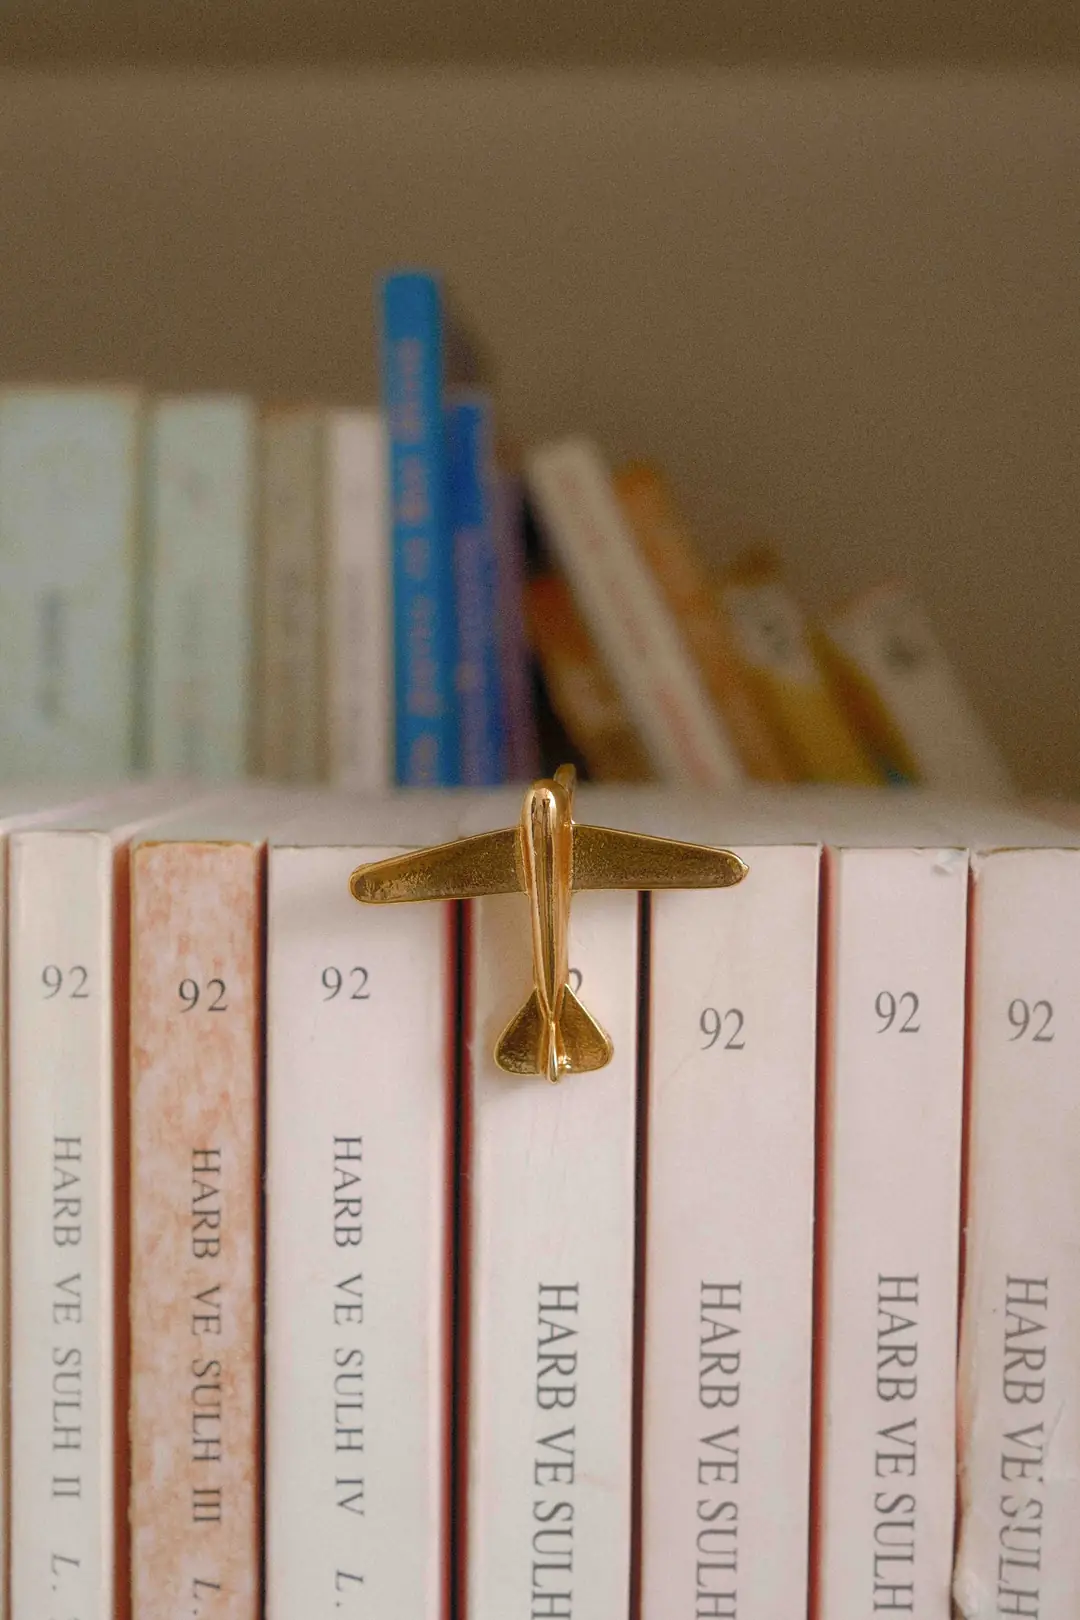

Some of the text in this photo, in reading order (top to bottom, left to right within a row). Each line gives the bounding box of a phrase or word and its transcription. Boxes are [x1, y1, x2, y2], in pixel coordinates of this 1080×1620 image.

[41, 965, 90, 999] 92
[178, 978, 228, 1013] 92
[321, 966, 370, 1002] 92
[699, 1008, 746, 1051] 92
[874, 991, 921, 1034] 92
[1007, 999, 1055, 1043] 92
[53, 1136, 82, 1248] HARB
[192, 1148, 222, 1260] HARB
[334, 1136, 363, 1248] HARB
[53, 1273, 82, 1324] VE
[192, 1284, 222, 1336] VE
[334, 1273, 364, 1325] VE
[52, 1348, 82, 1453] SULH
[192, 1359, 222, 1463] SULH
[334, 1348, 364, 1451] SULH
[531, 1282, 580, 1620] HARB VE SULH
[695, 1281, 743, 1620] HARB VE SULH
[873, 1273, 919, 1613] HARB VE SULH
[997, 1275, 1049, 1620] HARB VE SULH
[52, 1476, 81, 1498] II
[193, 1488, 222, 1523] III
[335, 1477, 365, 1516] IV
